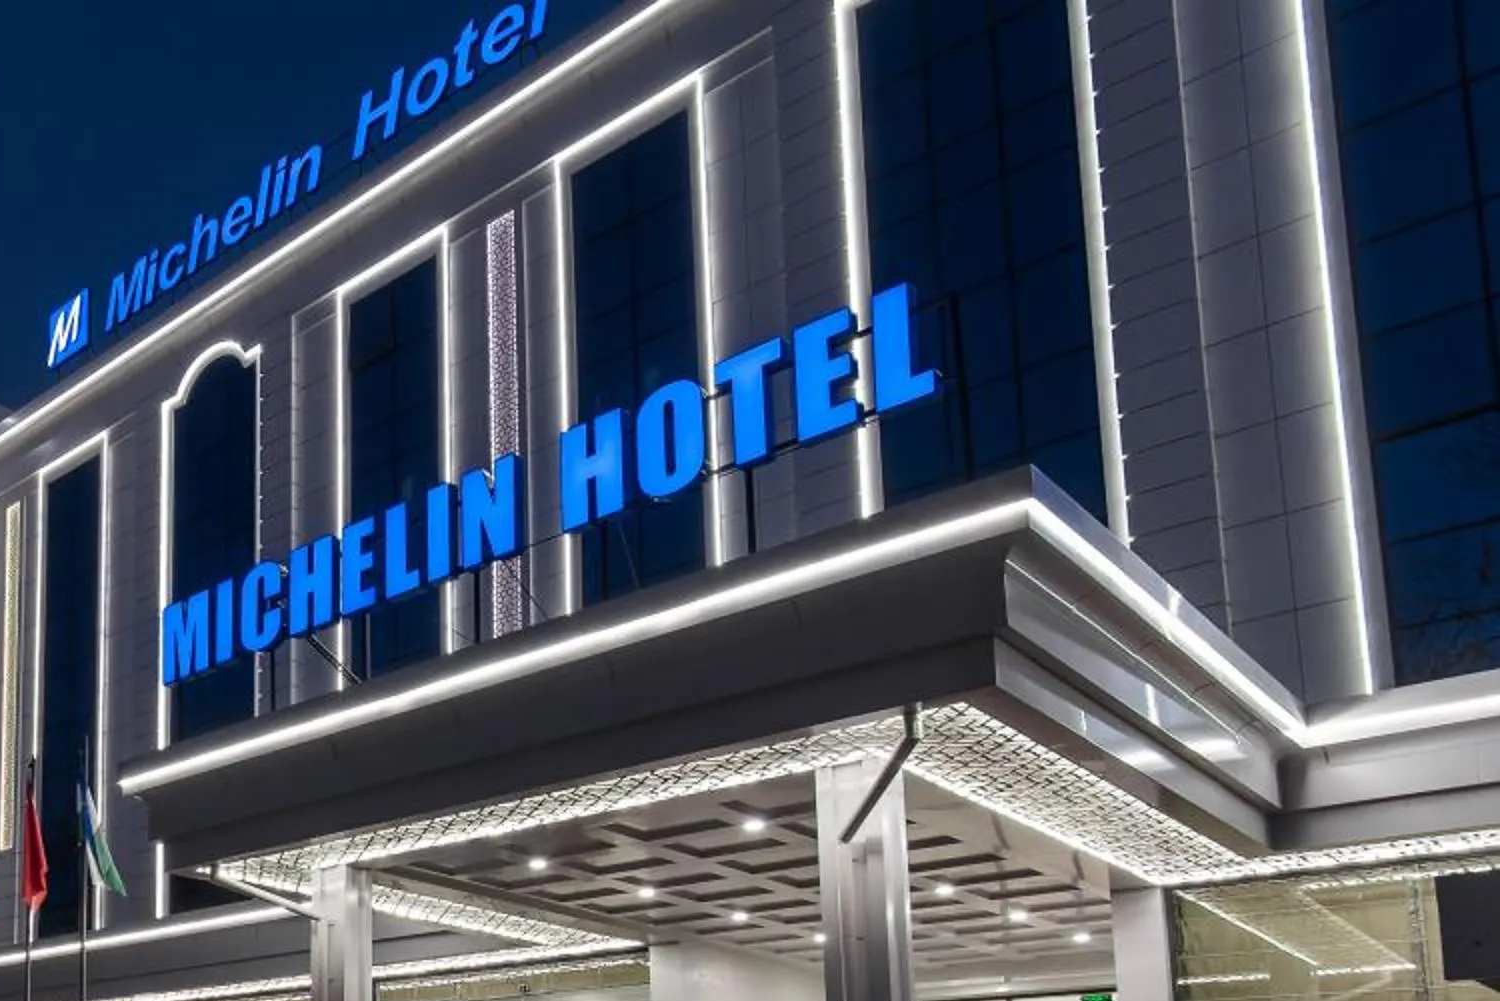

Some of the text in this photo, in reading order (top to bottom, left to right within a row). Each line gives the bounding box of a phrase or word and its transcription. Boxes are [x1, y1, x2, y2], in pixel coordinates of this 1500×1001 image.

[104, 145, 322, 331] Michelin
[163, 283, 940, 685] MICHELIN HOTEL
